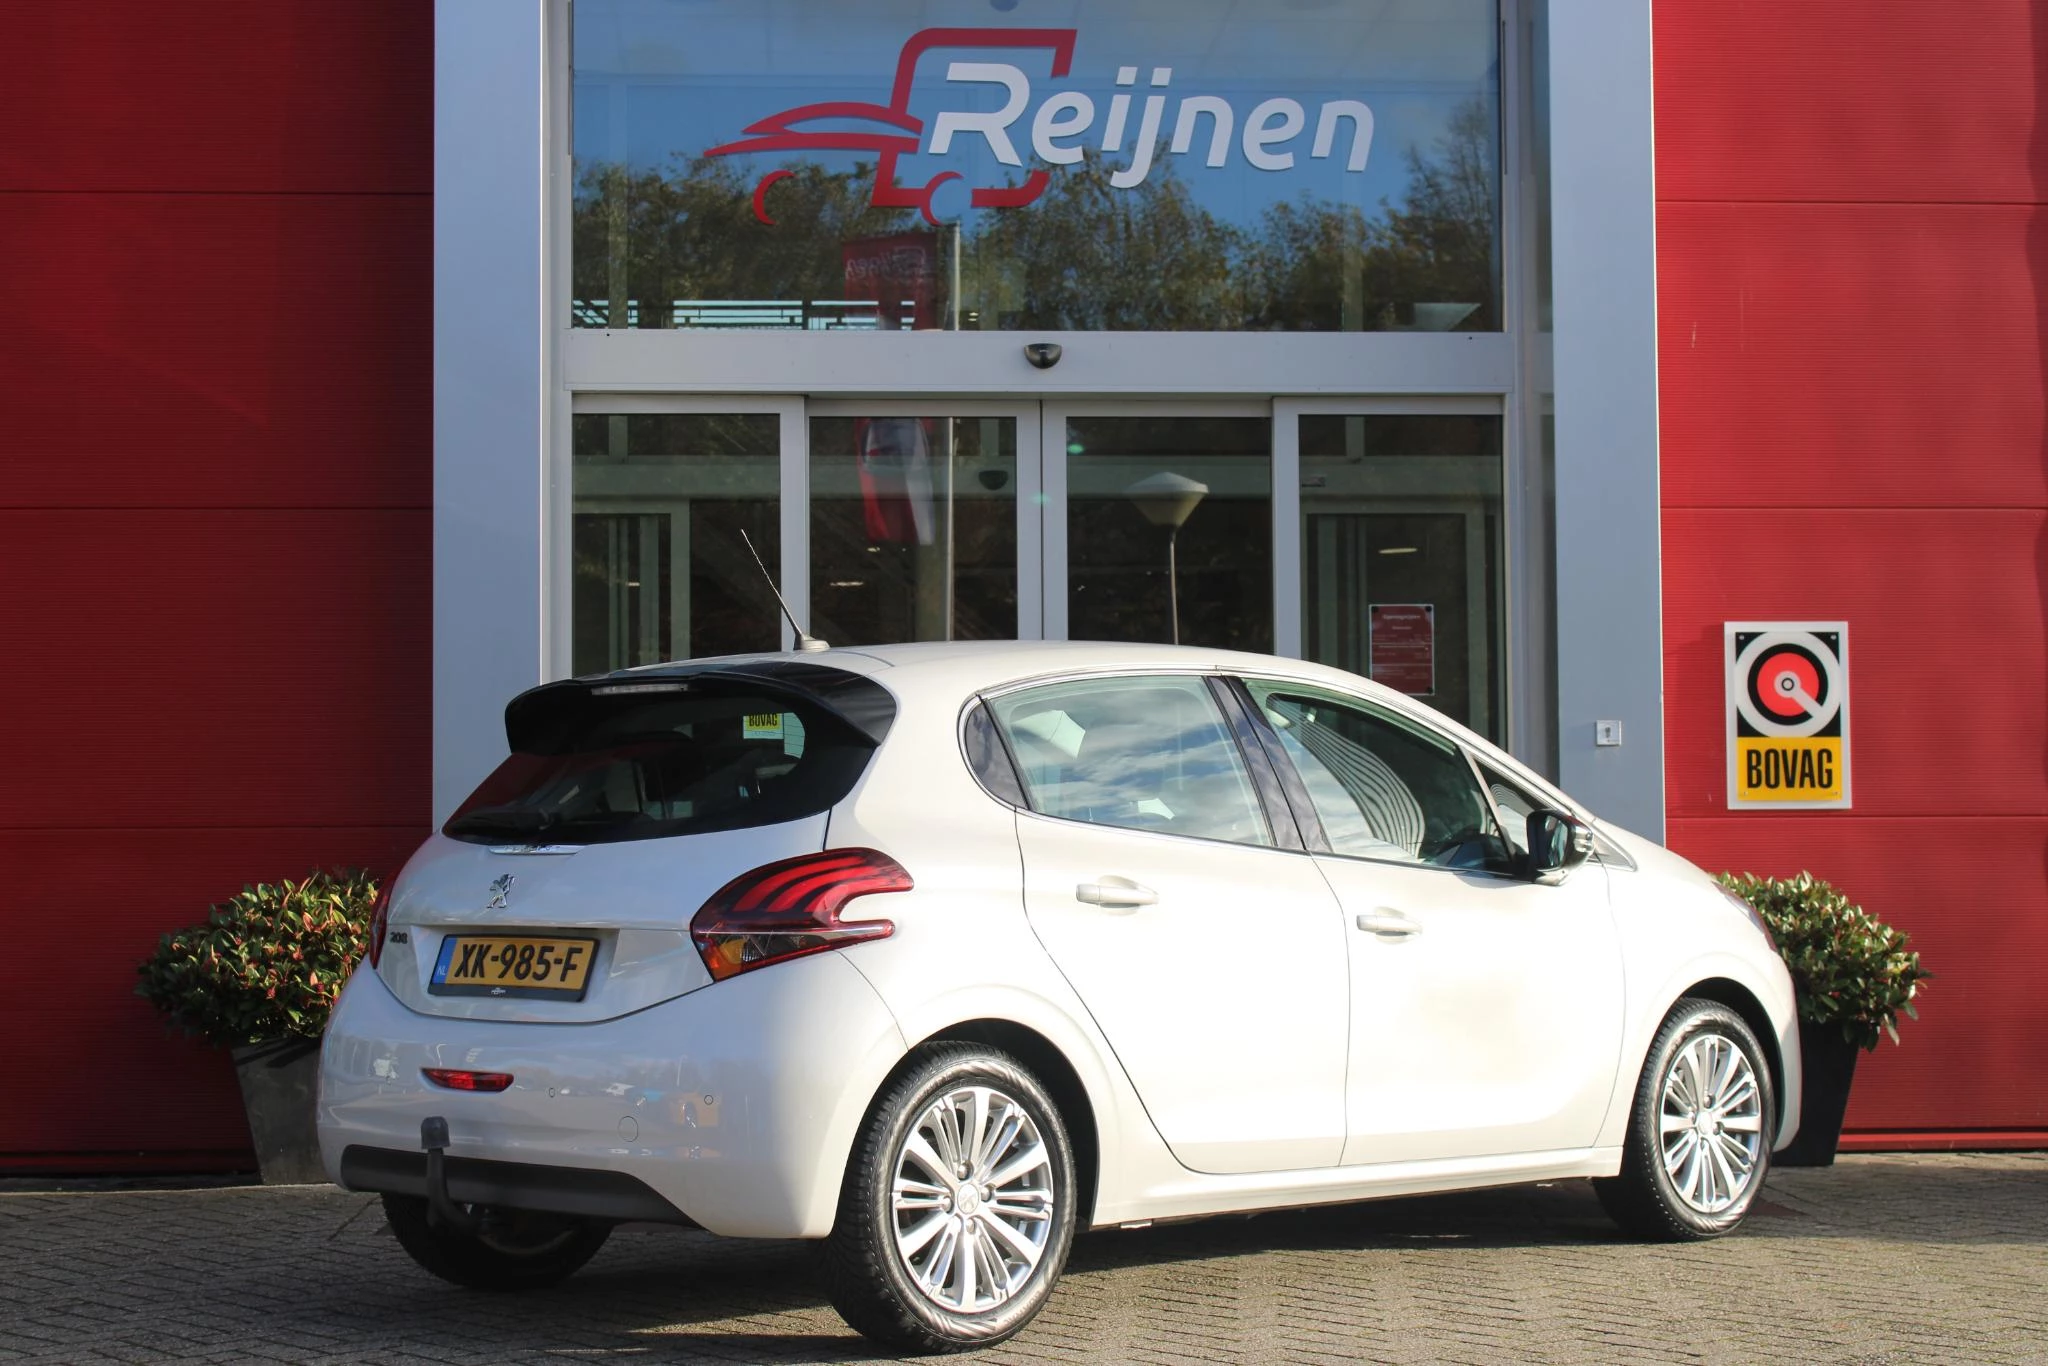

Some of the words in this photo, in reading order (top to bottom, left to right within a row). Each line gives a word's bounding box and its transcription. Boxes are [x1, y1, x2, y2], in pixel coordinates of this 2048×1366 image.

[928, 62, 1374, 189] Reijnen
[749, 713, 778, 727] BOVAG
[1746, 748, 1833, 789] BOVAG
[390, 931, 408, 945] 208
[454, 943, 583, 982] XK-985-F
